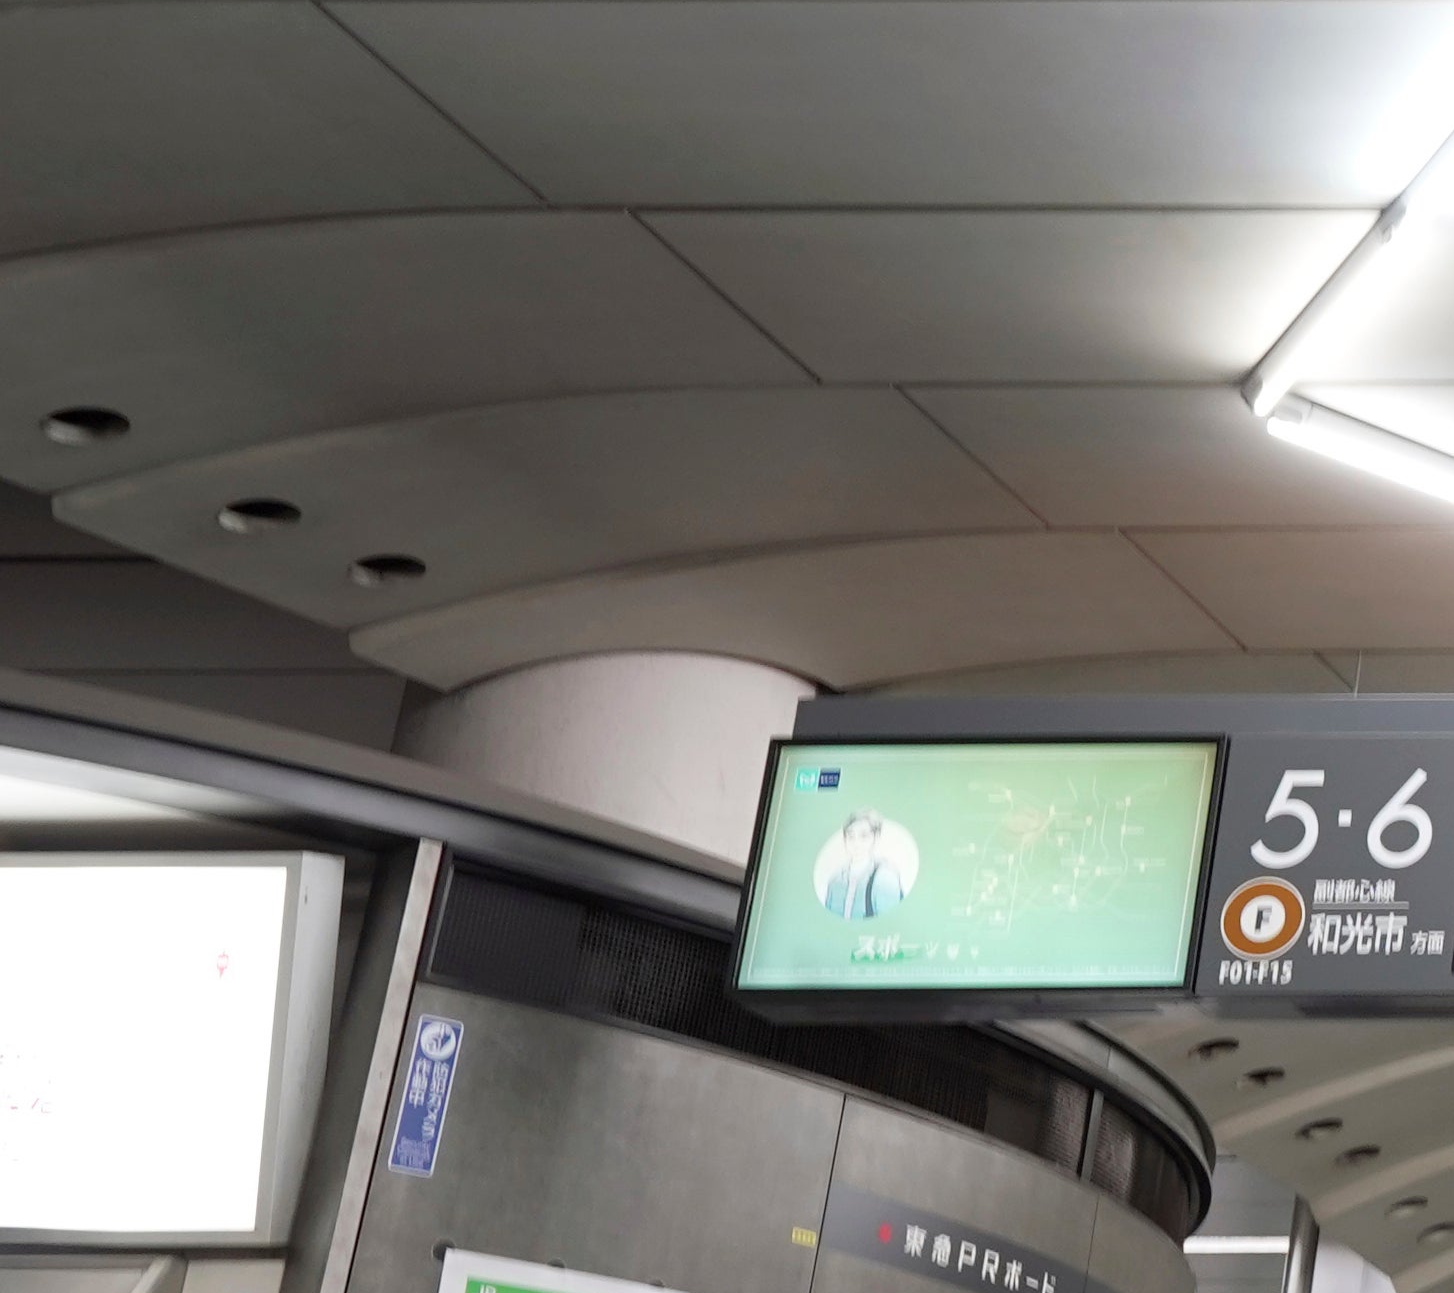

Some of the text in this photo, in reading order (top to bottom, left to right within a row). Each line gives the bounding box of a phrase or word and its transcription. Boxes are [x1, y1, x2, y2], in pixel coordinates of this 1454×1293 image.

[1307, 912, 1445, 955] 和光市 方面
